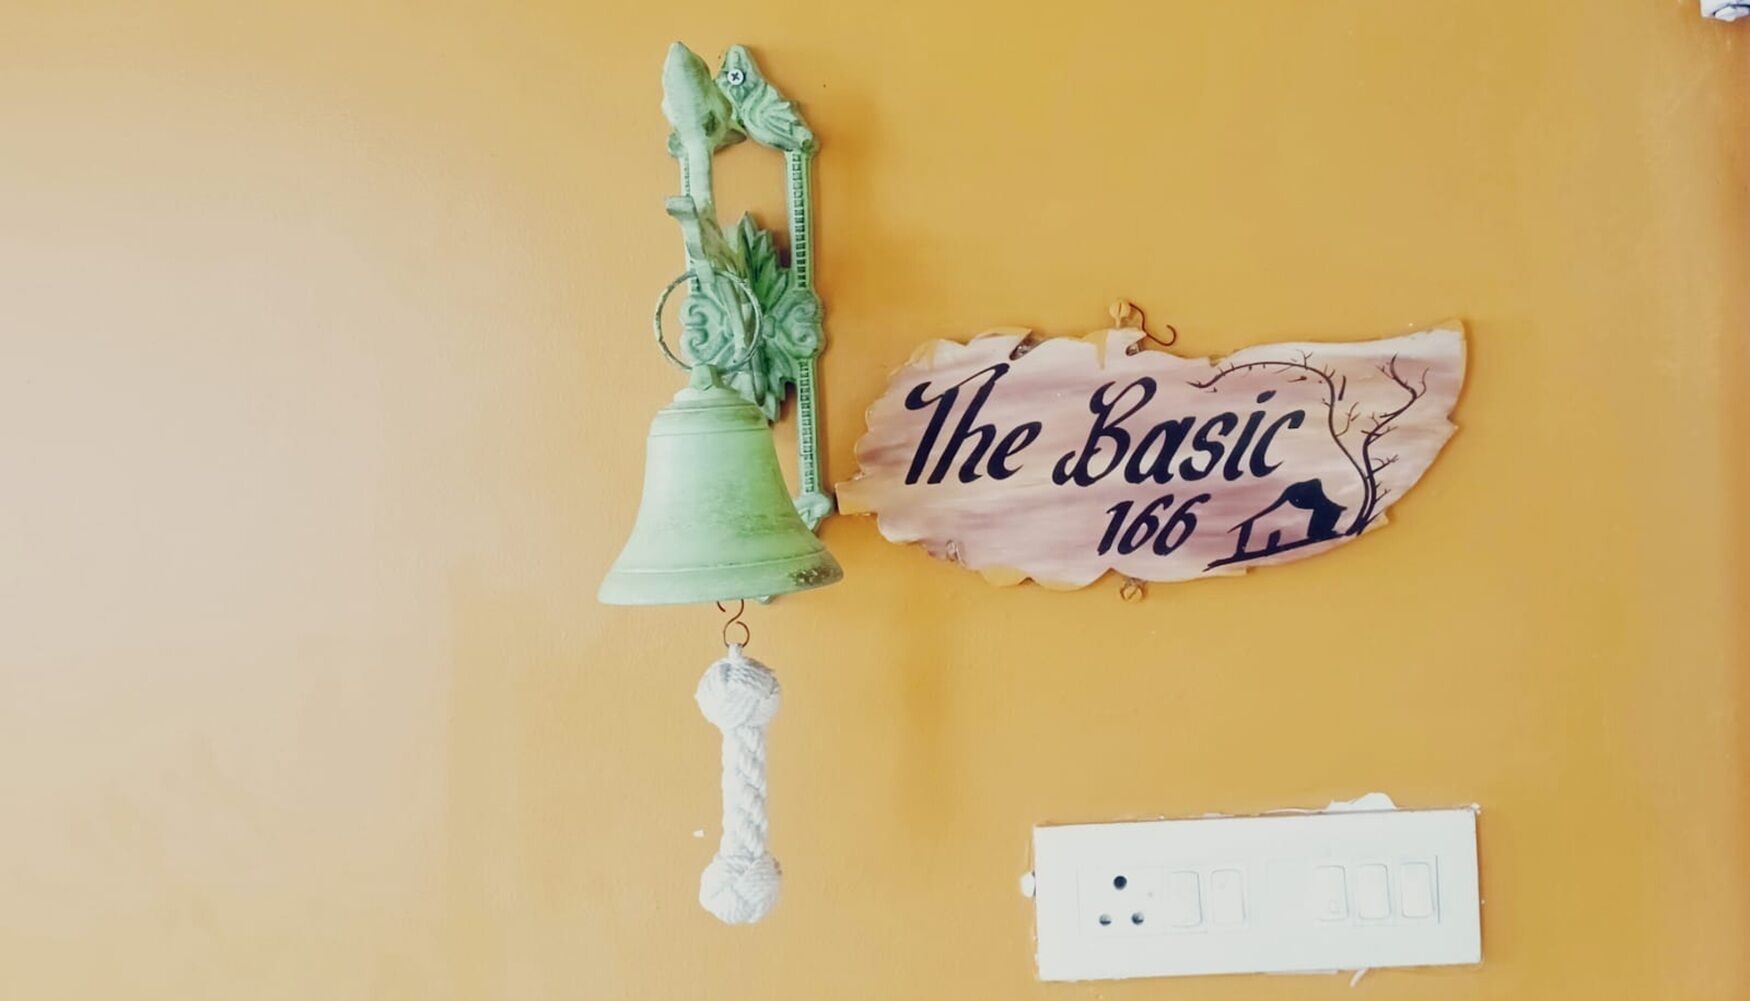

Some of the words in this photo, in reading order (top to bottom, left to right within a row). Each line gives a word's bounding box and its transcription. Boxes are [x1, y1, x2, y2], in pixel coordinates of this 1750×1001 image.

[904, 362, 1042, 485] The
[1052, 376, 1306, 487] Basic
[1097, 493, 1211, 556] 166
